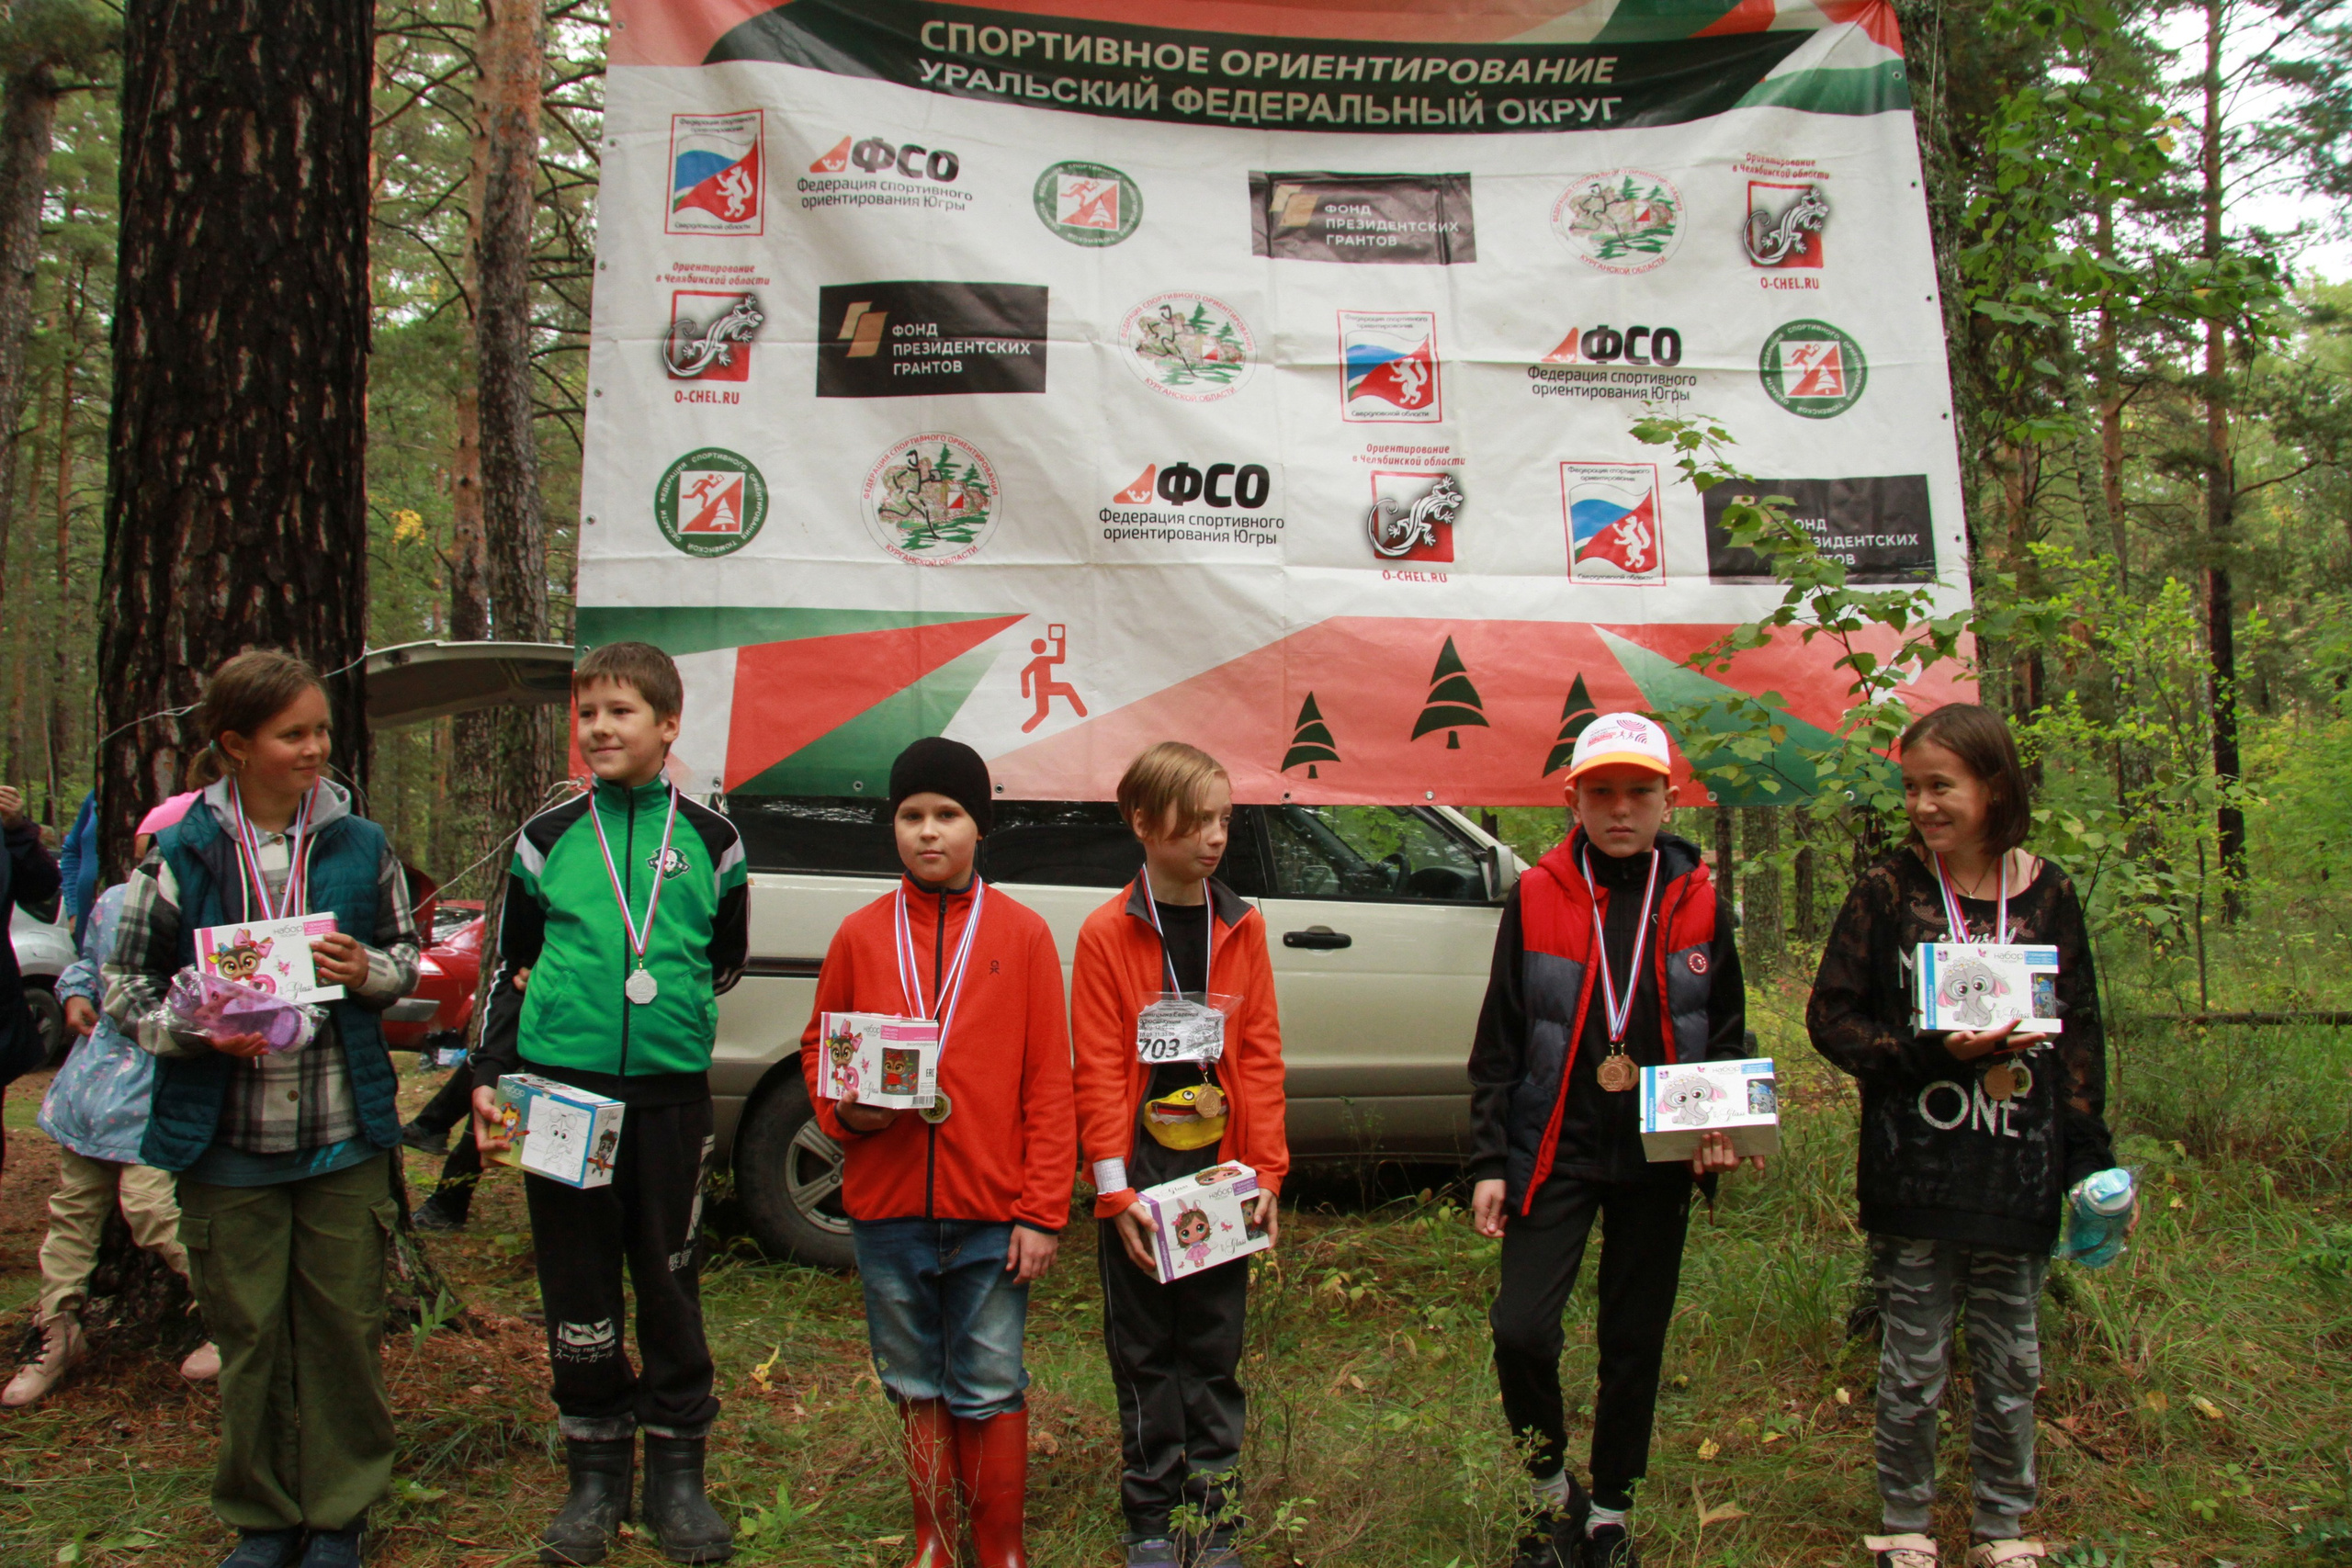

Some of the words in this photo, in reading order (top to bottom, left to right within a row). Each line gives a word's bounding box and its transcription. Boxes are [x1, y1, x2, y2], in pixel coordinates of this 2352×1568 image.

[921, 20, 1210, 73] СПОРТИВНОЕ
[1220, 50, 1618, 84] ОРИЕНТИРОВАНИЕ
[919, 59, 1159, 111] УРАЛЬСКИЙ
[1171, 86, 1484, 125] ФЕДЕРАЛЬНЫЙ
[1497, 97, 1622, 123] ОКРУГ
[852, 136, 959, 182] ФСО
[797, 177, 876, 193] Федерация
[880, 181, 973, 202] спортивного
[801, 195, 919, 210] ориентирования
[923, 195, 965, 212] Югры
[1325, 204, 1372, 216] ФОНД
[1326, 219, 1459, 232] ПРЕЗИДЕНТСКИХ
[1326, 235, 1397, 246] ГРАНТОВ
[673, 262, 755, 275] Ориентирование
[1579, 254, 1631, 275] КУРГАНСКОЙ
[1632, 255, 1667, 275] ОБЛАСТИ
[664, 274, 726, 285] Челябинской
[729, 275, 770, 285] области
[1760, 276, 1819, 289] O-CHEL.RU
[892, 323, 938, 337] ФОНД
[1142, 291, 1201, 308] СПОРТИВНОГО
[1202, 296, 1254, 352] ОРИЕНТИРОВАНИЯ
[1787, 324, 1840, 339] СПОРТИВНОГО
[893, 341, 1031, 356] ПРЕЗИДЕНТСКИХ
[1581, 324, 1681, 367] ФСО
[893, 360, 963, 376] ГРАНТОВ
[1528, 365, 1607, 383] Федерация
[1611, 370, 1697, 387] спортивного
[674, 390, 740, 404] O-CHEL.RU
[1144, 377, 1197, 402] КУРГАНСКОЙ
[1198, 386, 1237, 402] ОБЛАСТИ
[1532, 384, 1647, 400] ориентирования
[1651, 386, 1690, 402] Югры
[1366, 443, 1450, 456] Ориентирование
[691, 452, 748, 470] СПОРТИВНОГО
[864, 454, 890, 499] ФЕДЕРАЦИЯ
[889, 434, 947, 456] СПОРТИВНОГО
[947, 435, 998, 496] ОРИЕНТИРОВАНИЯ
[1360, 455, 1421, 467] Челябинской
[1423, 455, 1466, 467] области
[660, 462, 687, 503] ФЕДЕРАЦИЯ
[1157, 462, 1270, 509] ФСО
[1099, 508, 1184, 526] Федерация
[1188, 513, 1284, 530] спортивного
[1781, 518, 1827, 533] ОНД
[1103, 527, 1229, 543] ориентирования
[1234, 529, 1277, 547] Югры
[1781, 533, 1919, 550] ЗИДЕНТСКИХ
[687, 540, 738, 553] ТЮМЕНСКОЙ
[885, 543, 937, 567] КУРГАНСКОЙ
[938, 545, 978, 566] ОБЛАСТИ
[1382, 570, 1448, 583] O-CHEL.RU
[274, 924, 303, 934] набор
[1994, 951, 2024, 961] набор
[1139, 1038, 1180, 1059] 703
[1917, 1078, 2020, 1138] ONE
[1208, 1187, 1233, 1200] набор
